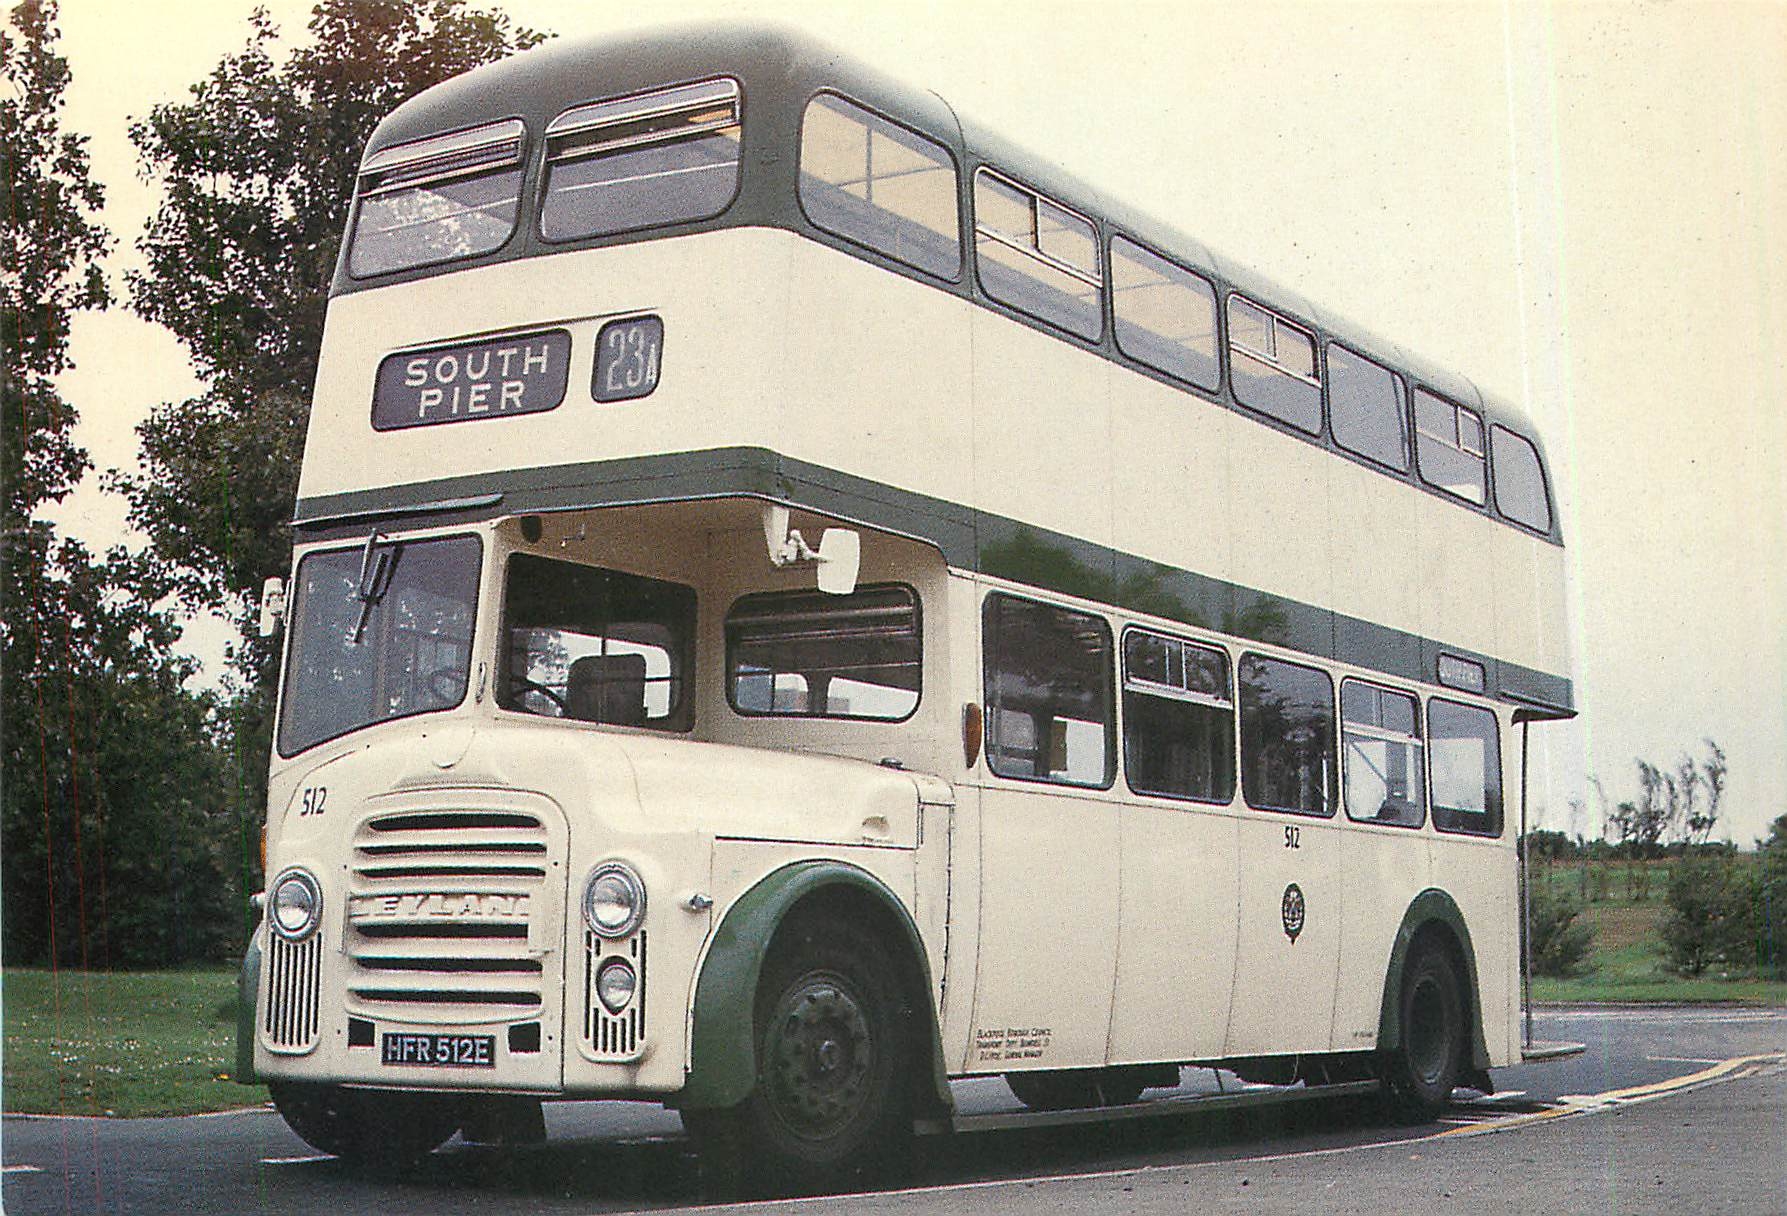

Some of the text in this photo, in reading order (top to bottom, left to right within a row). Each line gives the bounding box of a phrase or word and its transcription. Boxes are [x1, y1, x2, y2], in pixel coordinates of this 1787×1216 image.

[405, 344, 549, 387] SOUTH
[606, 326, 658, 392] 23A
[418, 380, 525, 418] PIER
[301, 786, 327, 817] 512
[1285, 825, 1300, 848] 512
[387, 1036, 489, 1064] HFR 512E
